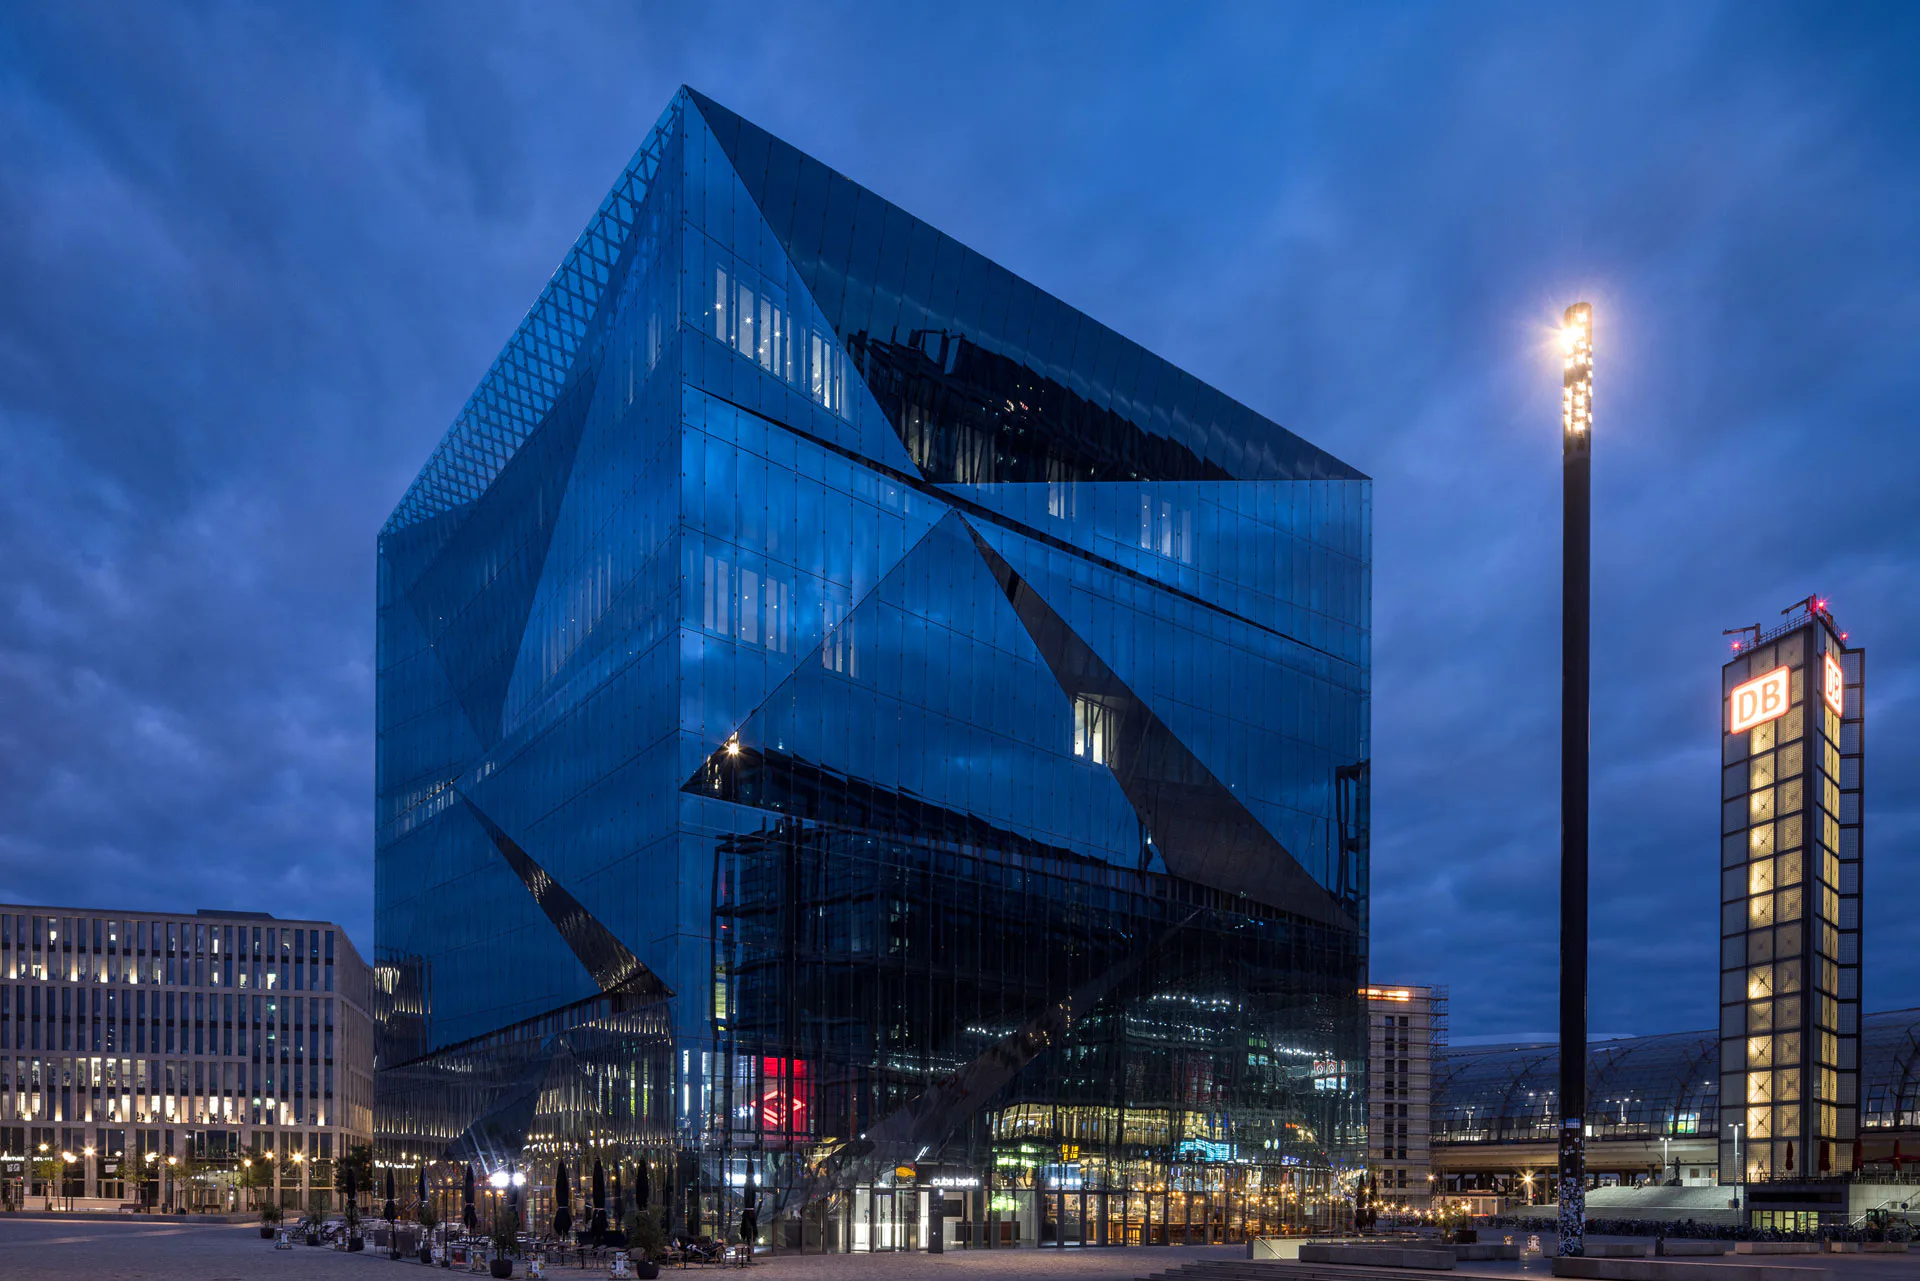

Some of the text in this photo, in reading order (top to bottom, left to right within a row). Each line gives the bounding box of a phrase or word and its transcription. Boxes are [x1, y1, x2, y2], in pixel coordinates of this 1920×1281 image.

[1738, 679, 1781, 723] DB
[1827, 665, 1840, 704] DB
[932, 1177, 979, 1186] cube berlin
